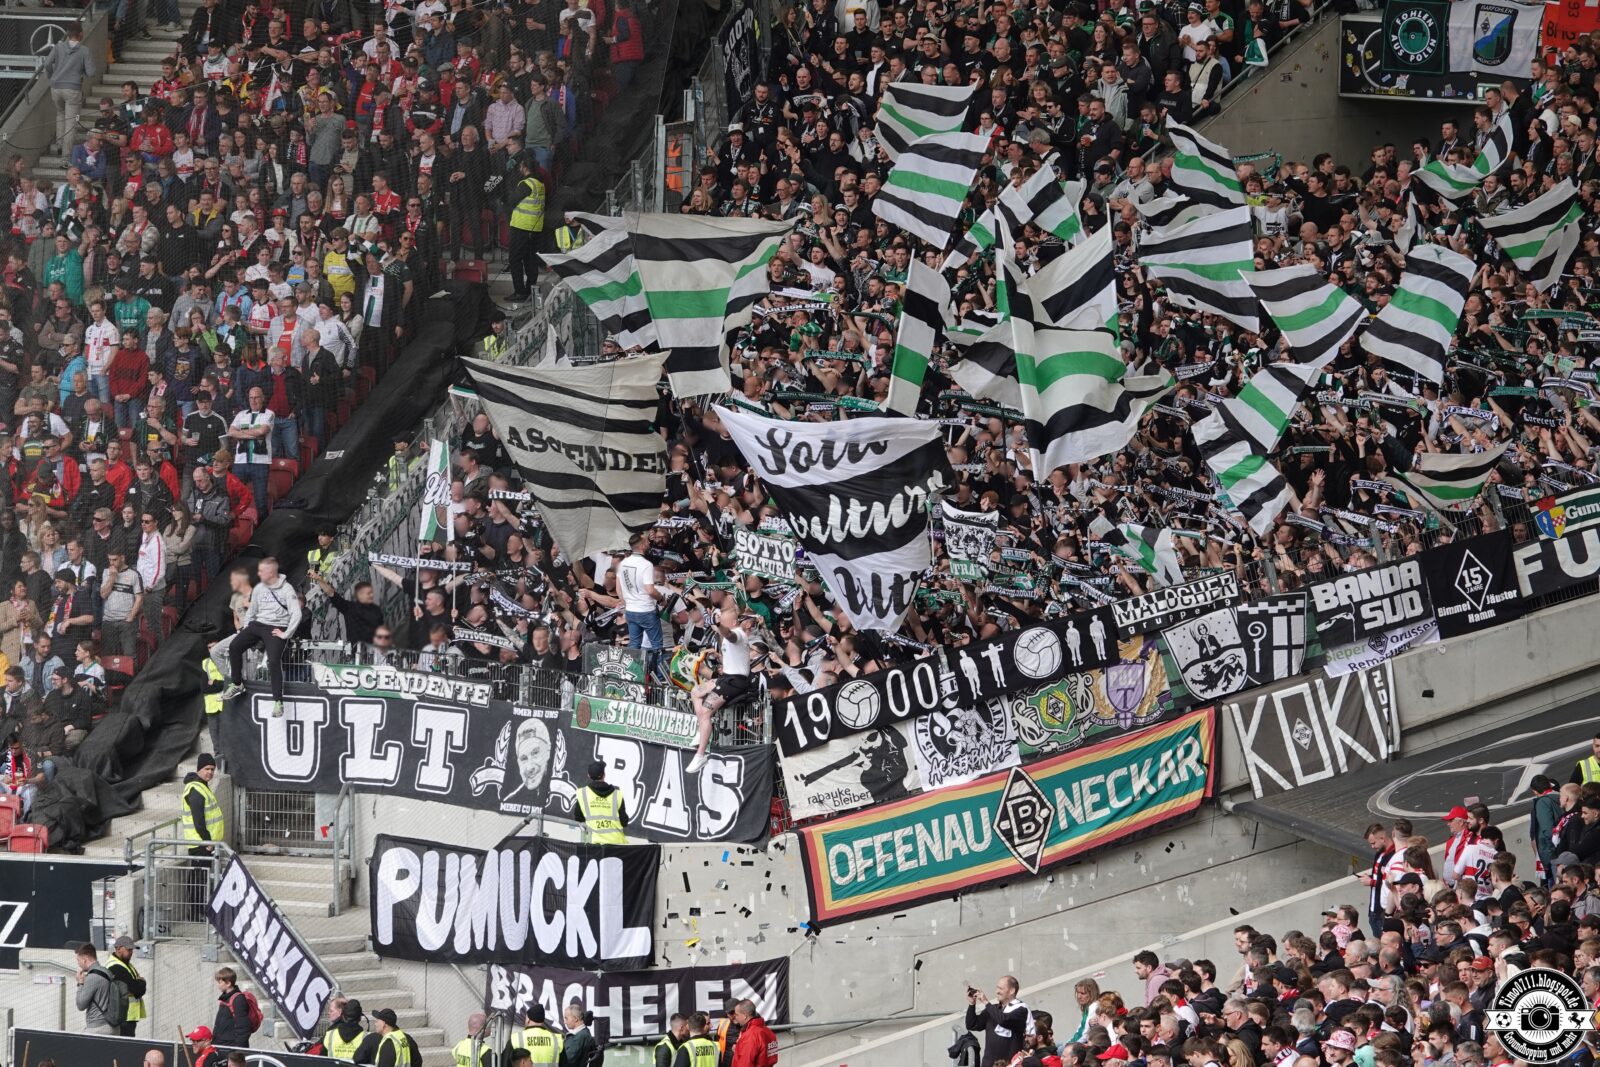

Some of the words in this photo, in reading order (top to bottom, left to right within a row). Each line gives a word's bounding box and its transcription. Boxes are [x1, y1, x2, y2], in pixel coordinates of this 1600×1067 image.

[1396, 10, 1434, 28] FOHLEN
[1391, 34, 1404, 57] AUS
[1409, 38, 1437, 62] POLEN
[736, 530, 793, 563] SOTTO
[1310, 560, 1422, 613] BANDA
[1462, 567, 1482, 588] 15
[1113, 573, 1236, 625] MALOCHER
[1360, 590, 1424, 631] SUD
[1437, 601, 1472, 618] Bimmel
[1468, 608, 1496, 624] Hamm
[319, 664, 492, 707] ASCENDENTE
[544, 710, 559, 719] UNS
[607, 699, 699, 738] STADIONVERBO
[928, 738, 1013, 787] ACKERBANDE
[807, 787, 851, 805] rabauke
[828, 806, 993, 888] OFFENAU
[1053, 734, 1206, 832] NECKAR
[376, 847, 652, 959] PUMUCKL
[211, 859, 330, 1031] PINKIS
[527, 1036, 553, 1046] SECURITY
[695, 1045, 715, 1056] SECURITY
